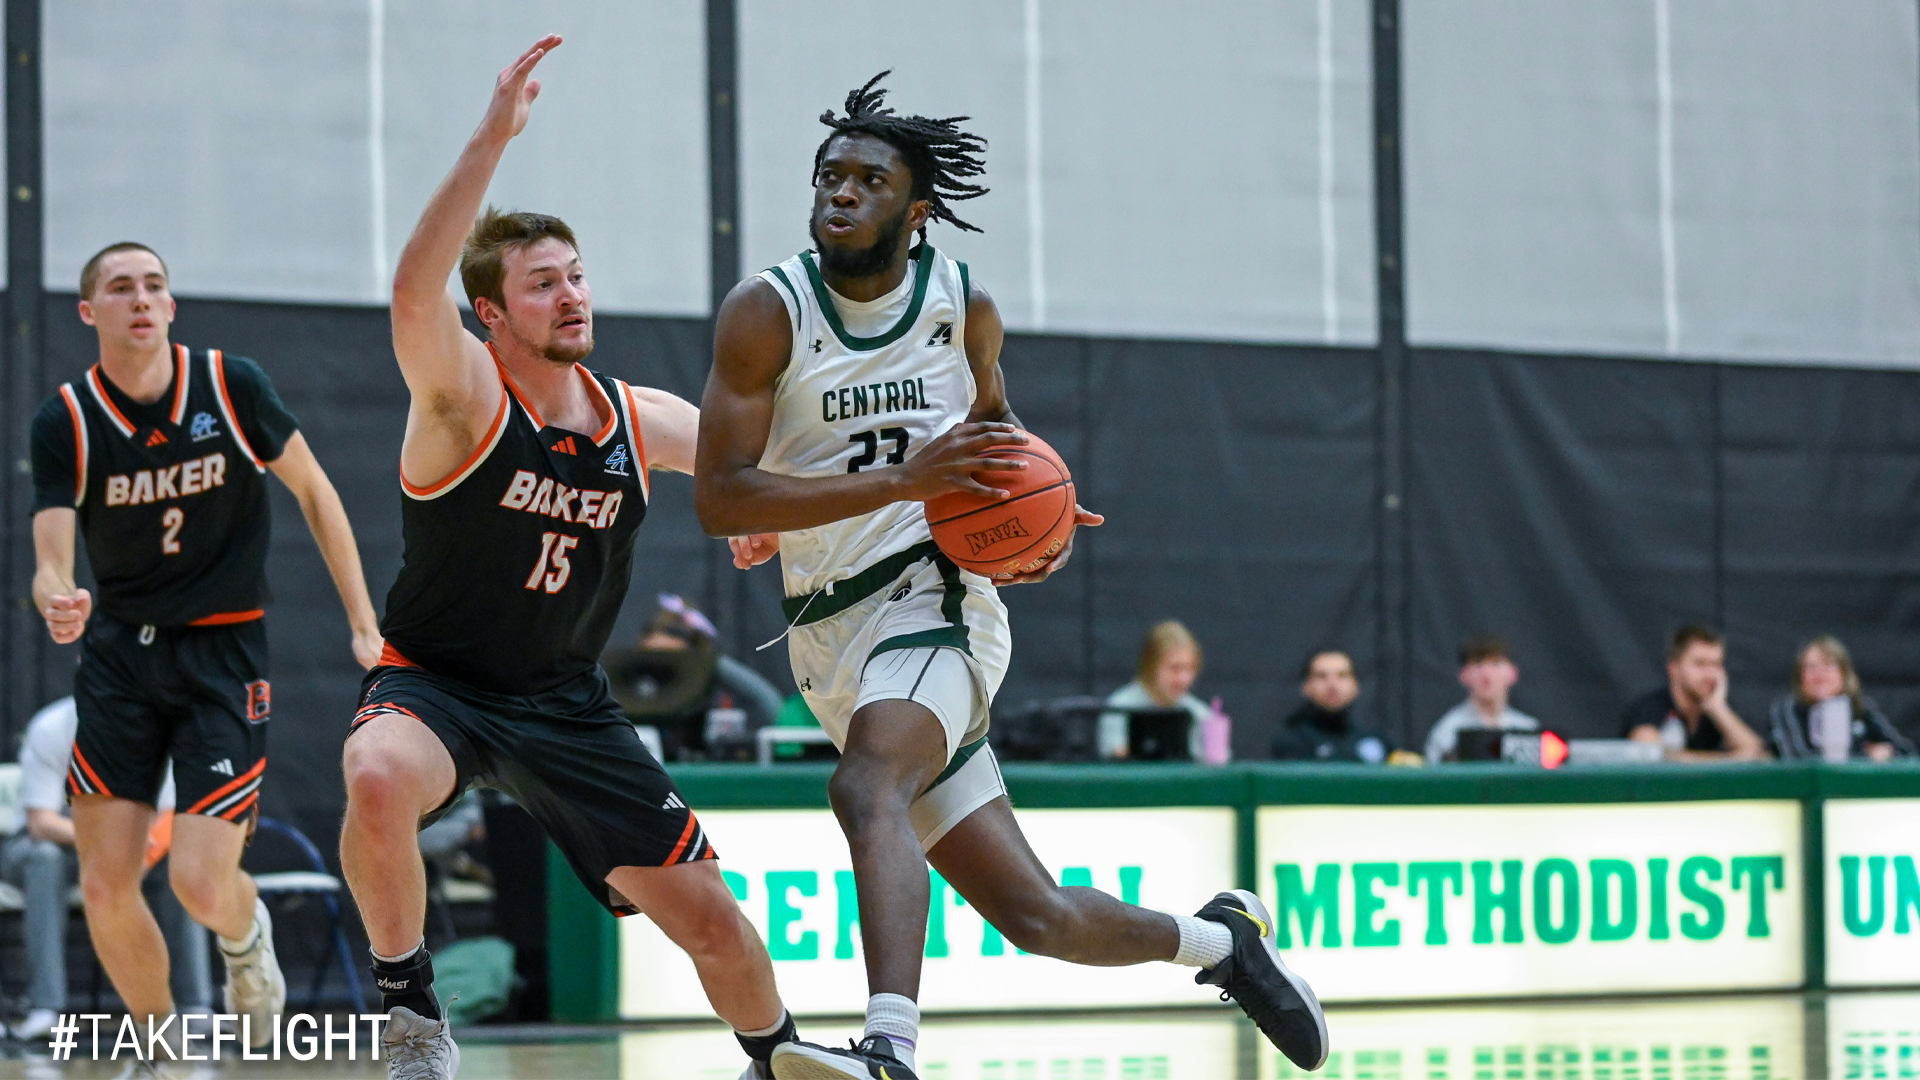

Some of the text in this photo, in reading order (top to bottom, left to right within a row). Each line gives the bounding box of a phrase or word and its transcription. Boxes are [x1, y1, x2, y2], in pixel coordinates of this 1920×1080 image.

[822, 377, 930, 423] CENTRAL
[847, 426, 909, 474] 23
[106, 452, 226, 507] BAKER
[499, 469, 624, 529] BAKER
[162, 507, 184, 553] 2
[964, 516, 1030, 556] NAIA
[525, 531, 579, 594] 15
[1274, 855, 1785, 950] METHODIST
